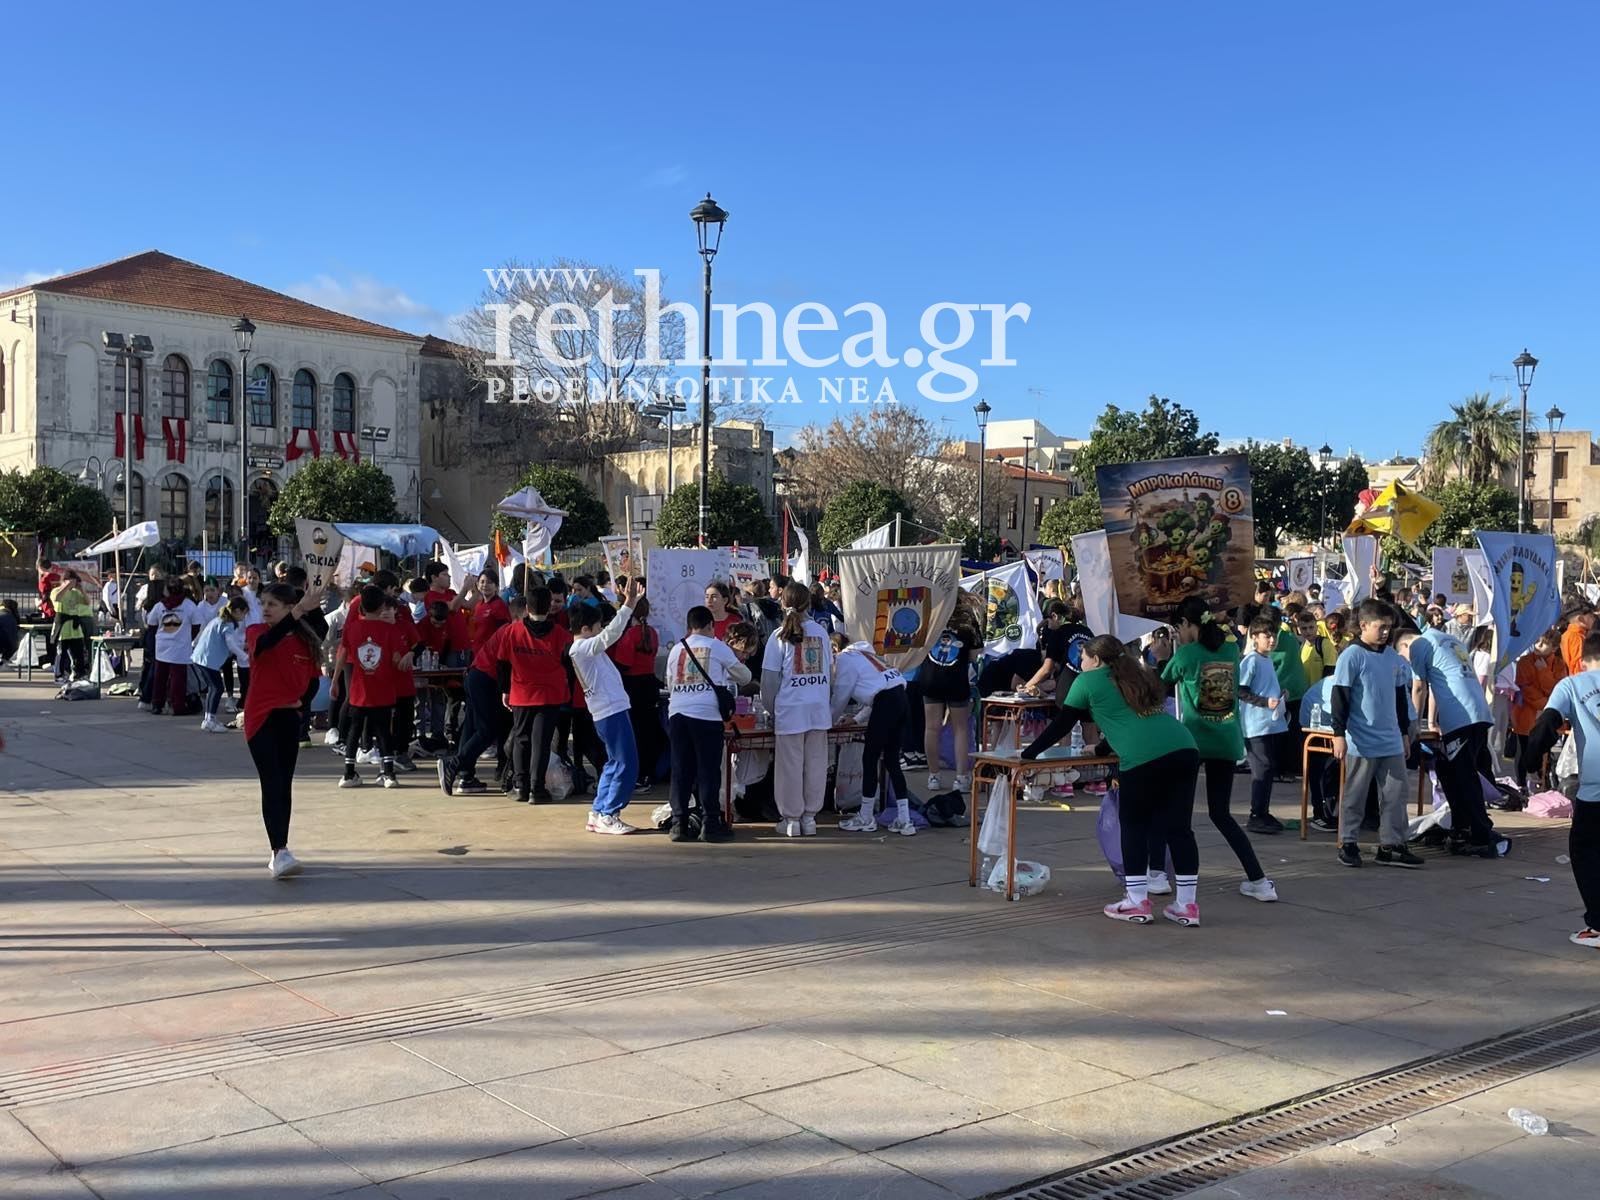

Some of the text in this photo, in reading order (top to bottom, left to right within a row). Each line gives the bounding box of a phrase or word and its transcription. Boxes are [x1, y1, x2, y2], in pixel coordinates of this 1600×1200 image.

[1225, 489, 1240, 510] 8
[681, 564, 695, 577] 88
[791, 675, 827, 687] ΣΟΦΙΑ
[673, 683, 712, 694] ΜΑΝΟΣ
